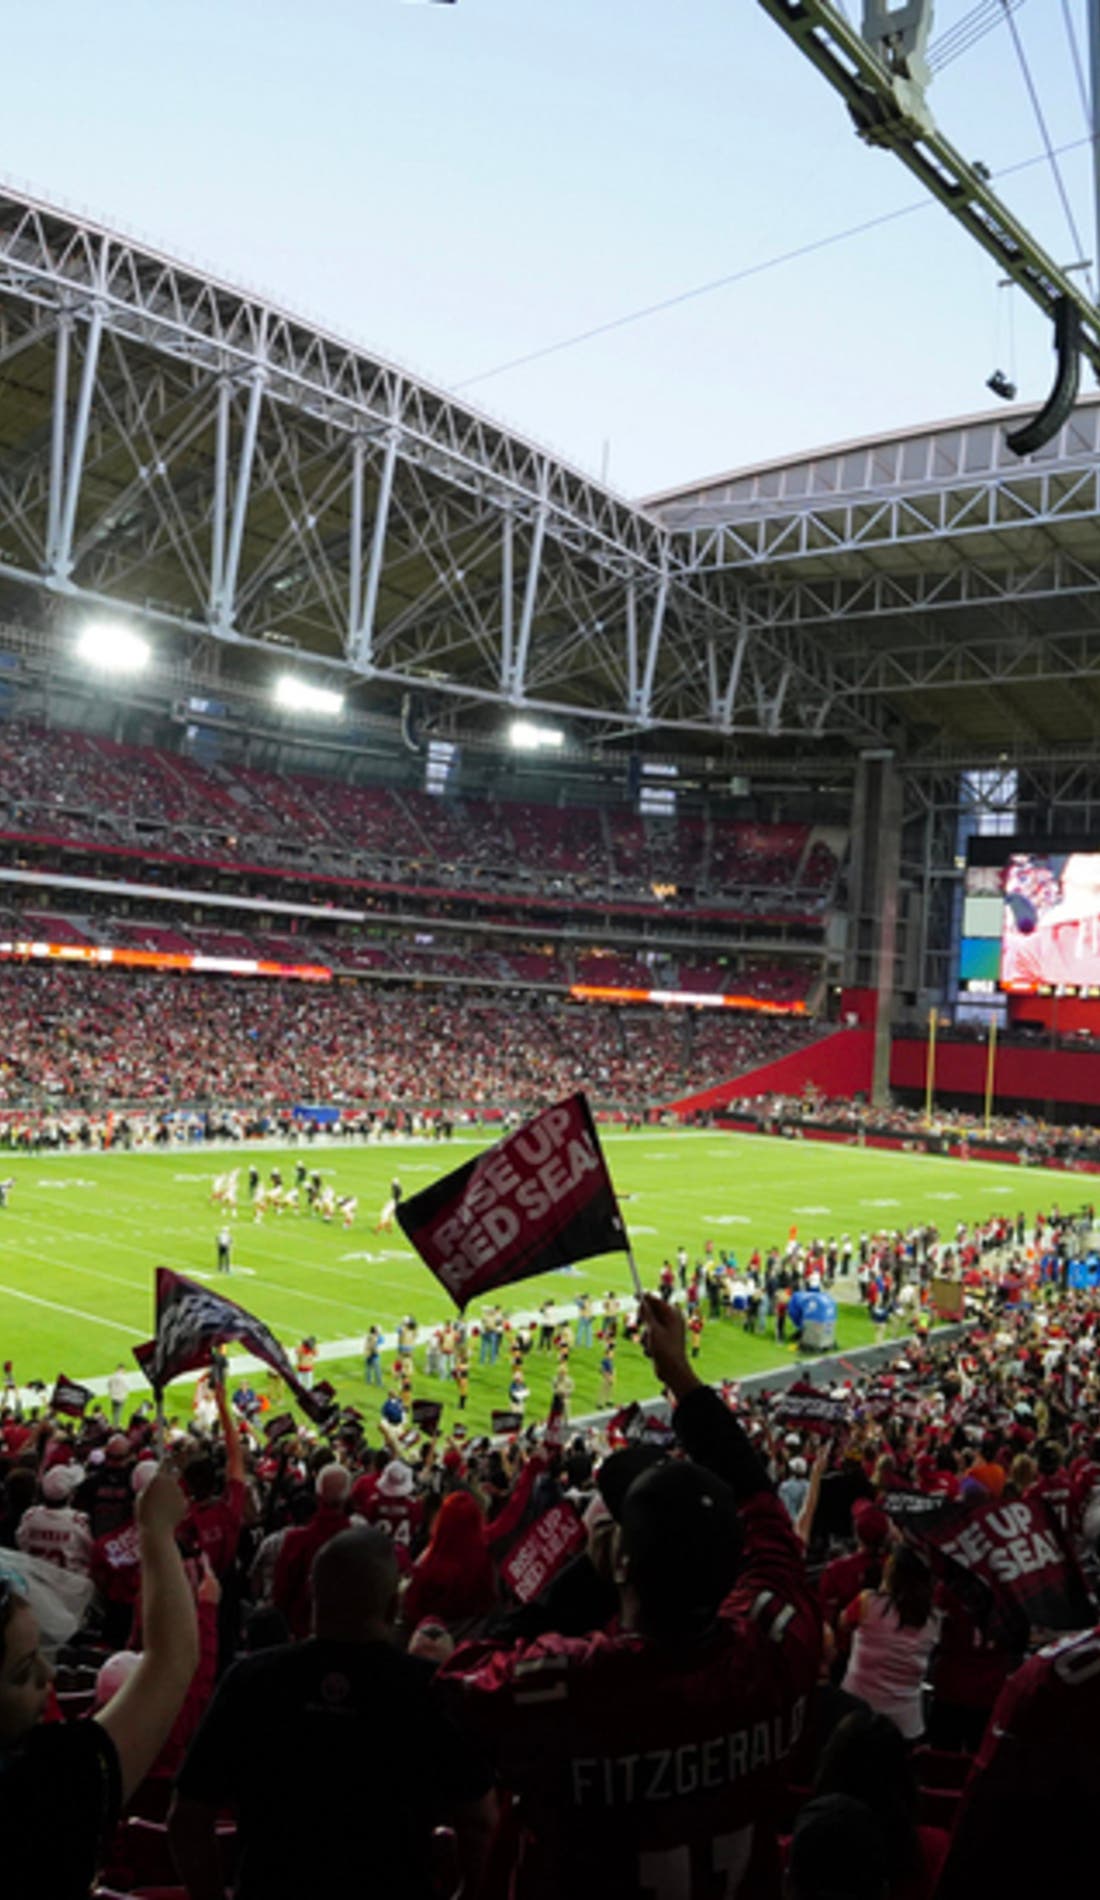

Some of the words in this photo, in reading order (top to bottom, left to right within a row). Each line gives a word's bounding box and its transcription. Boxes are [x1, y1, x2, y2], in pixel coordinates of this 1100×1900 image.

[513, 1108, 571, 1168] UP
[437, 1205, 520, 1294] RED
[985, 1501, 1033, 1540] UP
[571, 1696, 807, 1807] FITZGERALD
